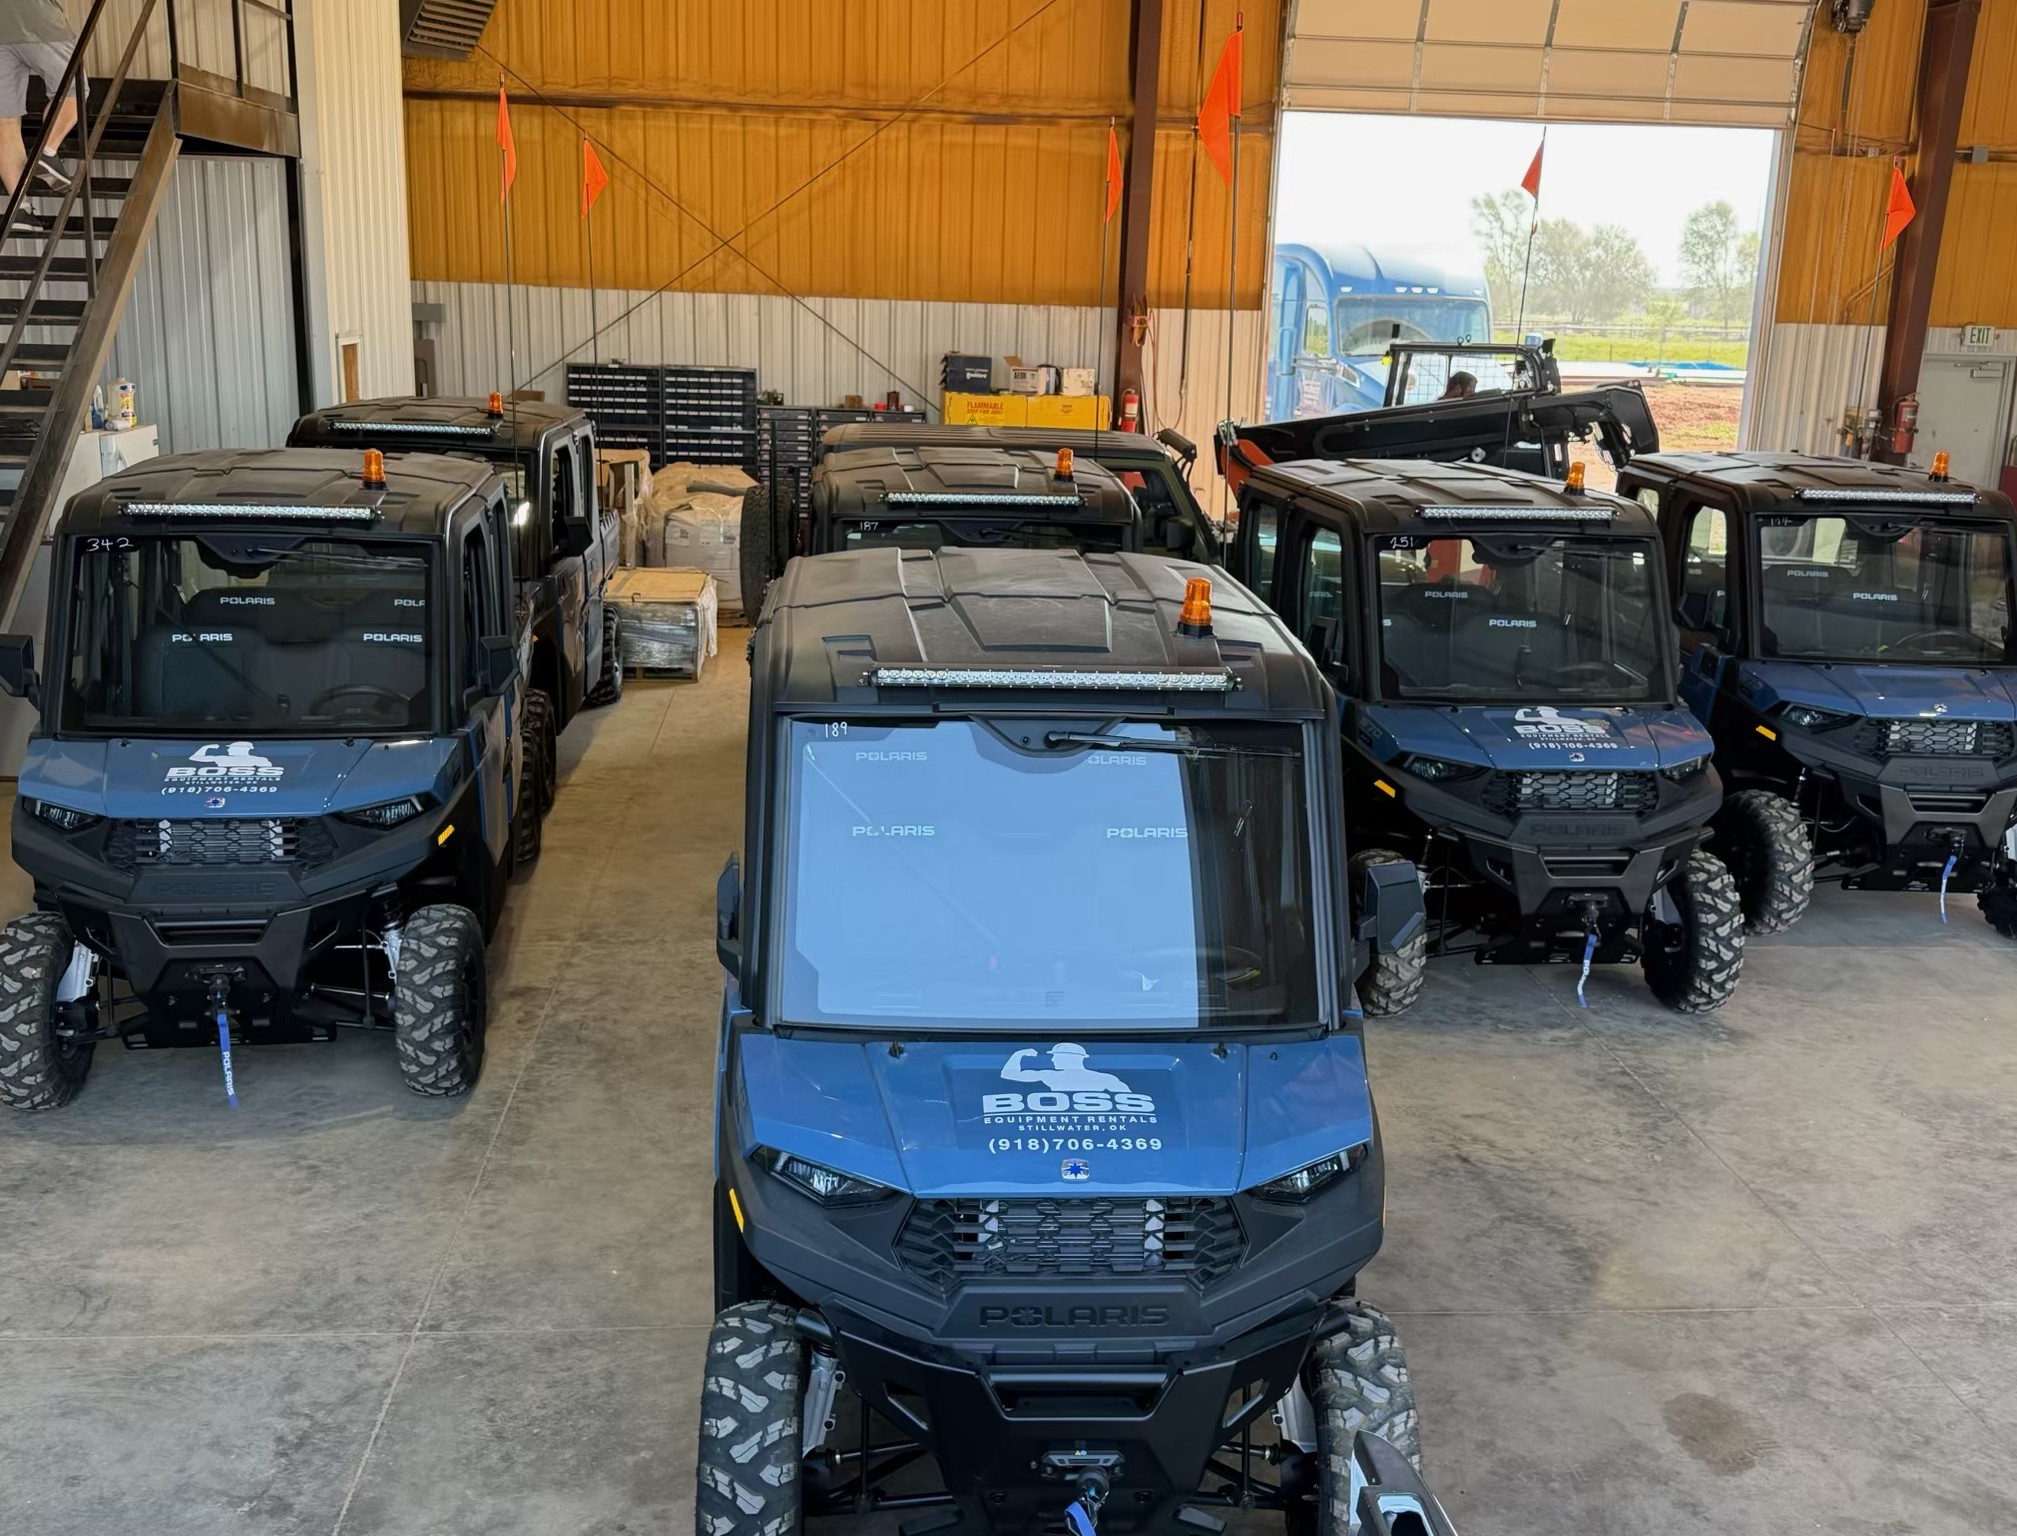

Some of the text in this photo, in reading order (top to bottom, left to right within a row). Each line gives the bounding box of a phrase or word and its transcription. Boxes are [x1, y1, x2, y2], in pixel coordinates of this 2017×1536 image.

[1970, 326, 1991, 344] EXIT
[966, 401, 1004, 410] FLAMMABLE
[859, 521, 879, 531] 187
[86, 537, 134, 552] 342
[1390, 536, 1414, 549] 251
[1786, 569, 1829, 578] POLARIS
[1425, 590, 1468, 599] POLARIS
[1852, 592, 1898, 601] POLARIS
[220, 596, 276, 605] POLARIS
[394, 598, 426, 607] POLA
[1489, 618, 1537, 628] POLARIS
[172, 633, 233, 643] POARIS
[363, 633, 423, 643] POLARIS
[824, 721, 848, 738] 189
[1513, 725, 1606, 734] BOSS
[855, 751, 928, 761] POLARIS
[1086, 755, 1147, 766] OLARIS
[165, 766, 285, 777] BOSS
[161, 786, 278, 796] (918)706-4369
[1106, 827, 1188, 839] POLARIS
[222, 1051, 235, 1095] POLARIS
[982, 1092, 1156, 1113] BOSS
[983, 1115, 1158, 1125] EQUIPMENT RENTALS
[988, 1137, 1163, 1154] (918)706-4369
[979, 1305, 1171, 1328] POLARIS
